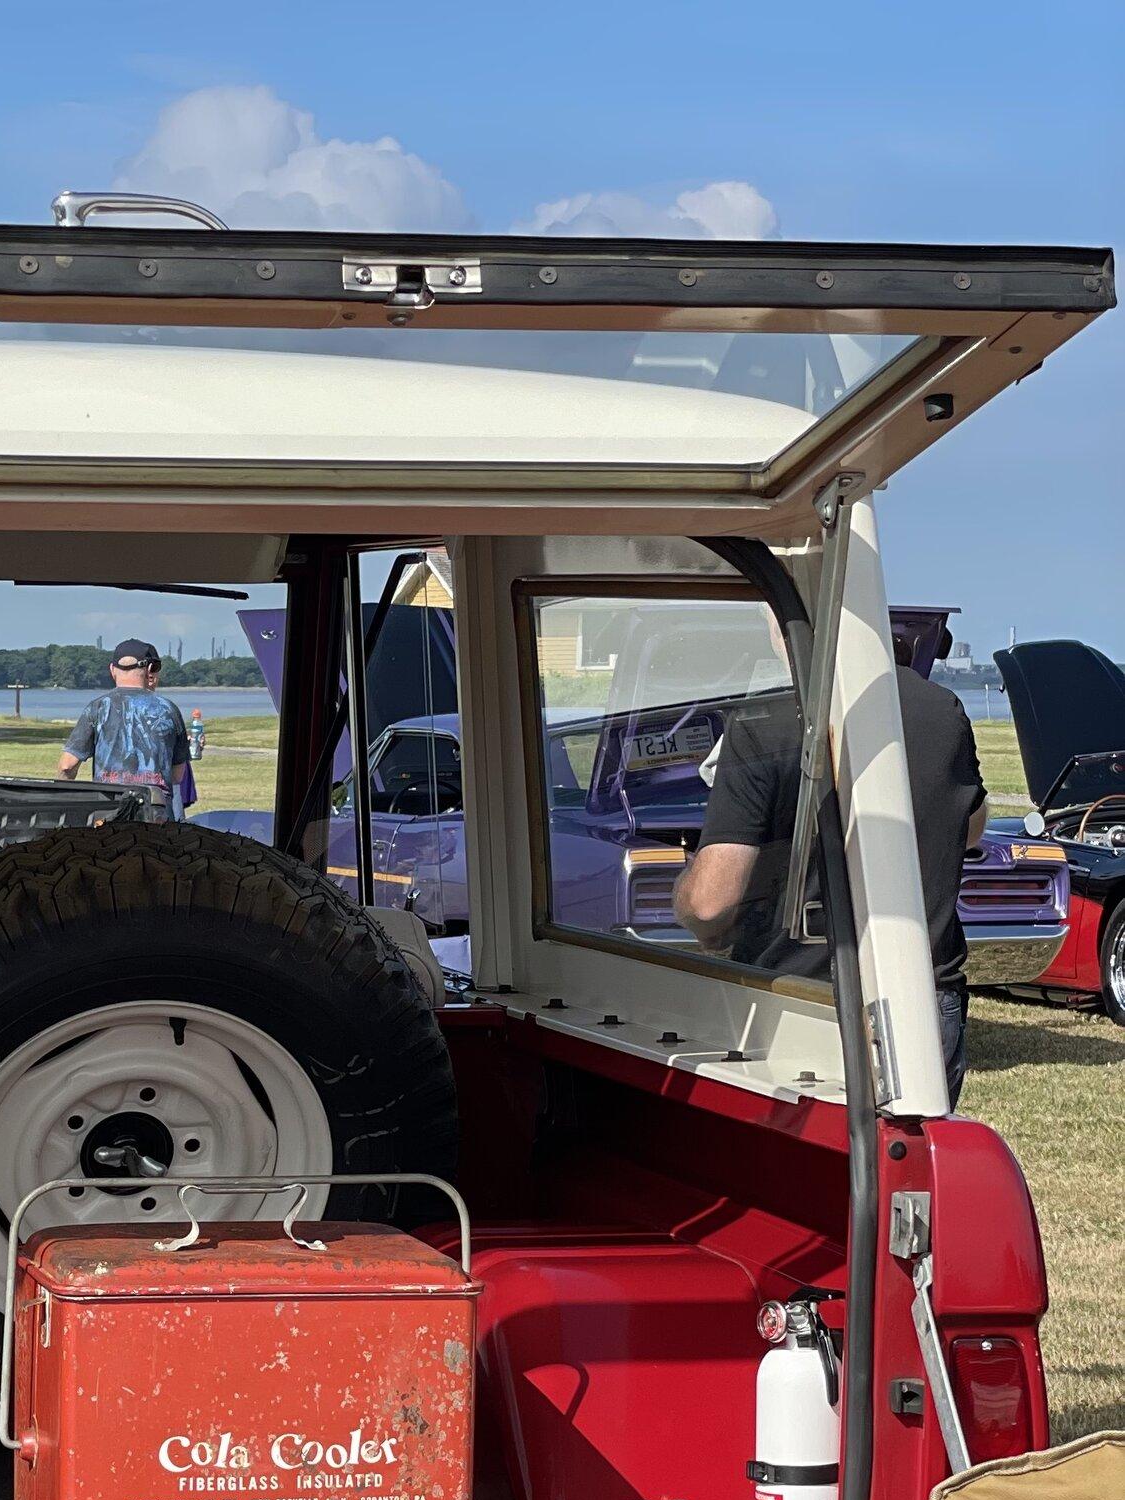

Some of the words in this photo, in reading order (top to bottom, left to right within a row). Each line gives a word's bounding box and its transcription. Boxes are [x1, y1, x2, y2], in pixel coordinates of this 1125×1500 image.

[158, 1432, 251, 1473] Cola
[270, 1428, 398, 1471] Cooler
[178, 1474, 279, 1492] FIBERGLASS
[296, 1473, 384, 1490] INSULATED
